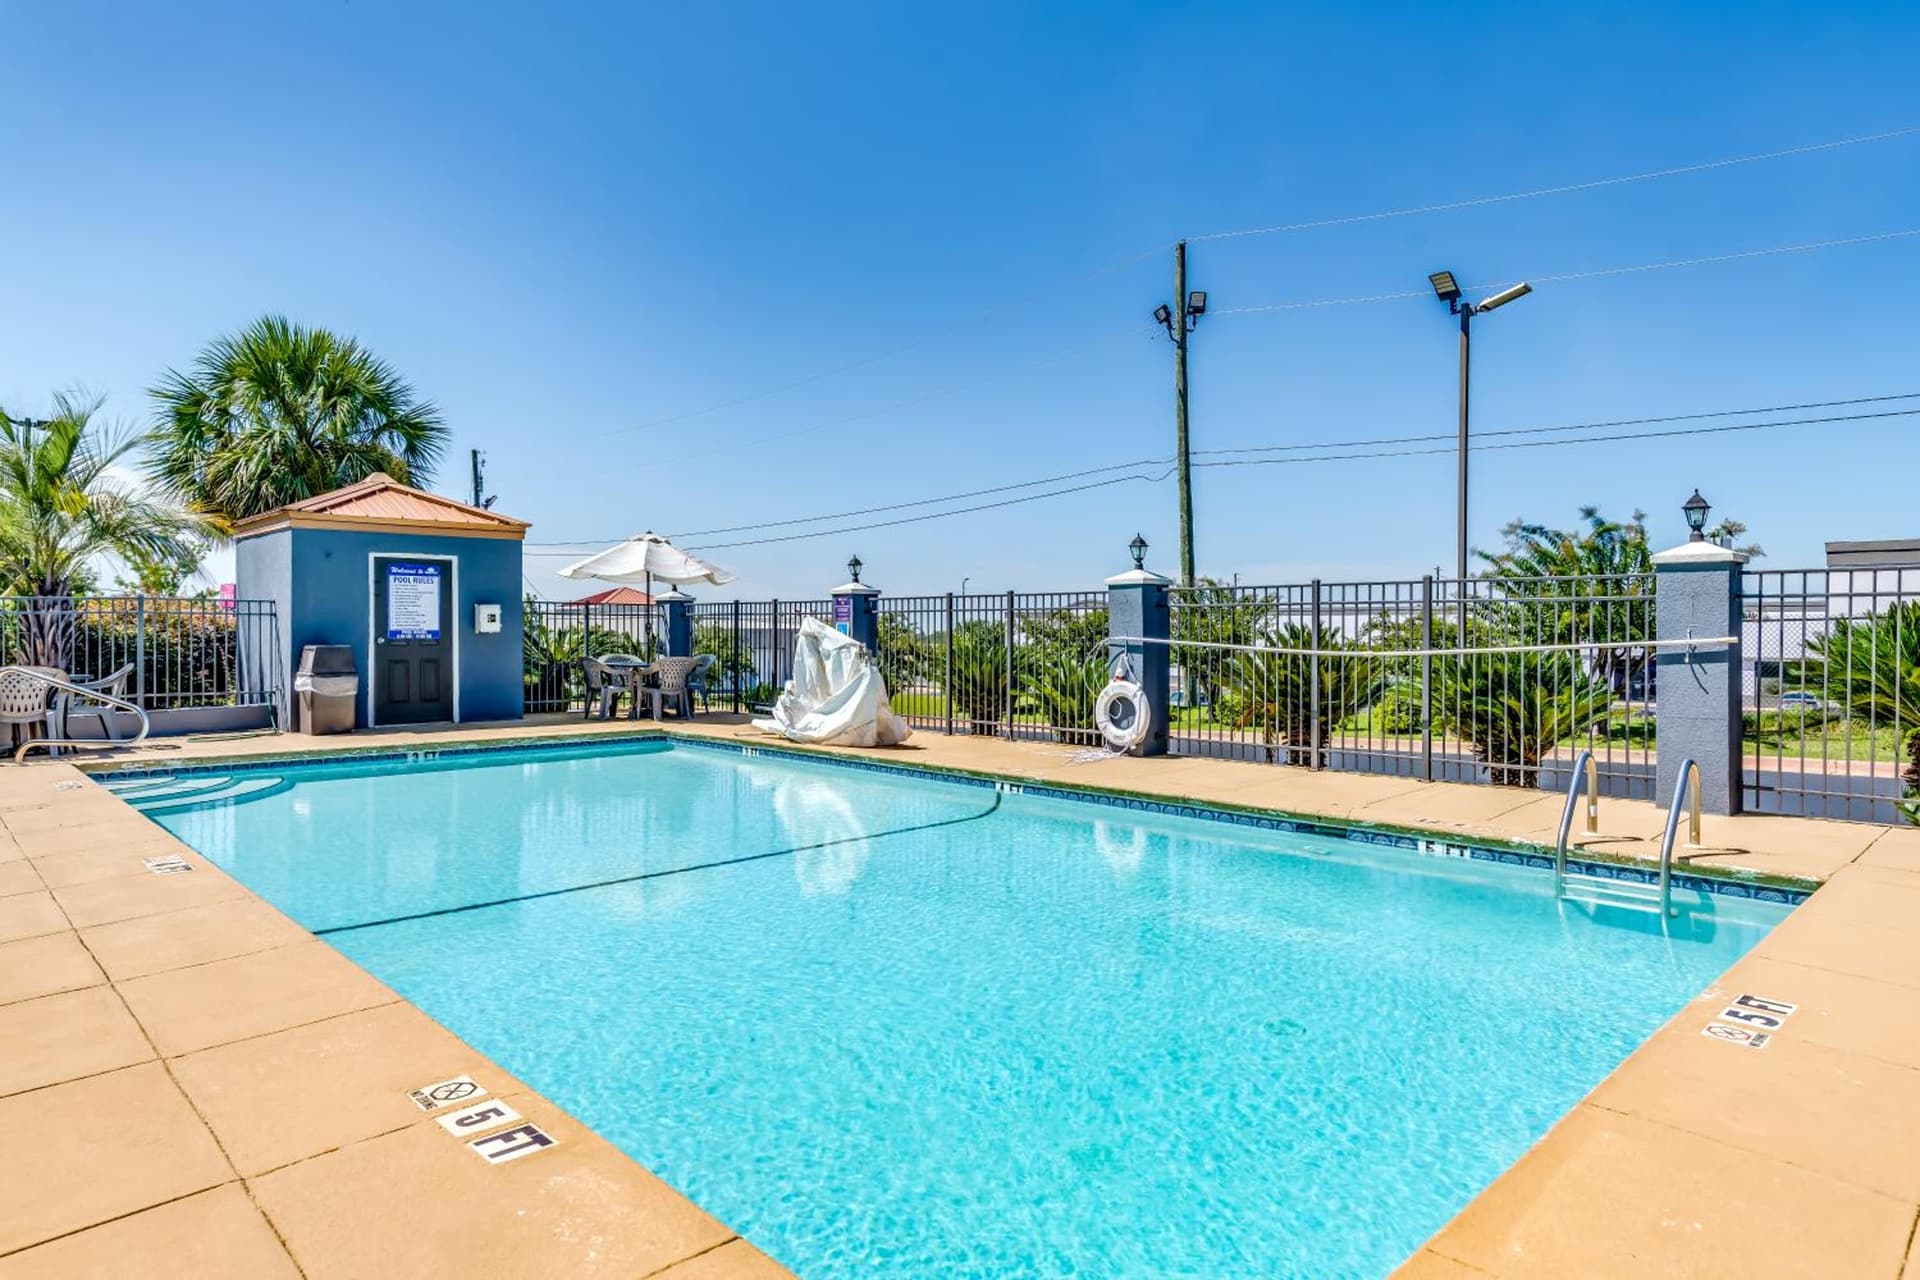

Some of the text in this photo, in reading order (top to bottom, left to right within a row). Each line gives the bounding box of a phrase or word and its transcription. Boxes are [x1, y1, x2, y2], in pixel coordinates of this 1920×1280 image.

[394, 576, 434, 585] POOL RULES
[1425, 840, 1468, 857] 5 FT
[1725, 994, 1792, 1027] 5 FT
[456, 1107, 554, 1159] 5 FT
